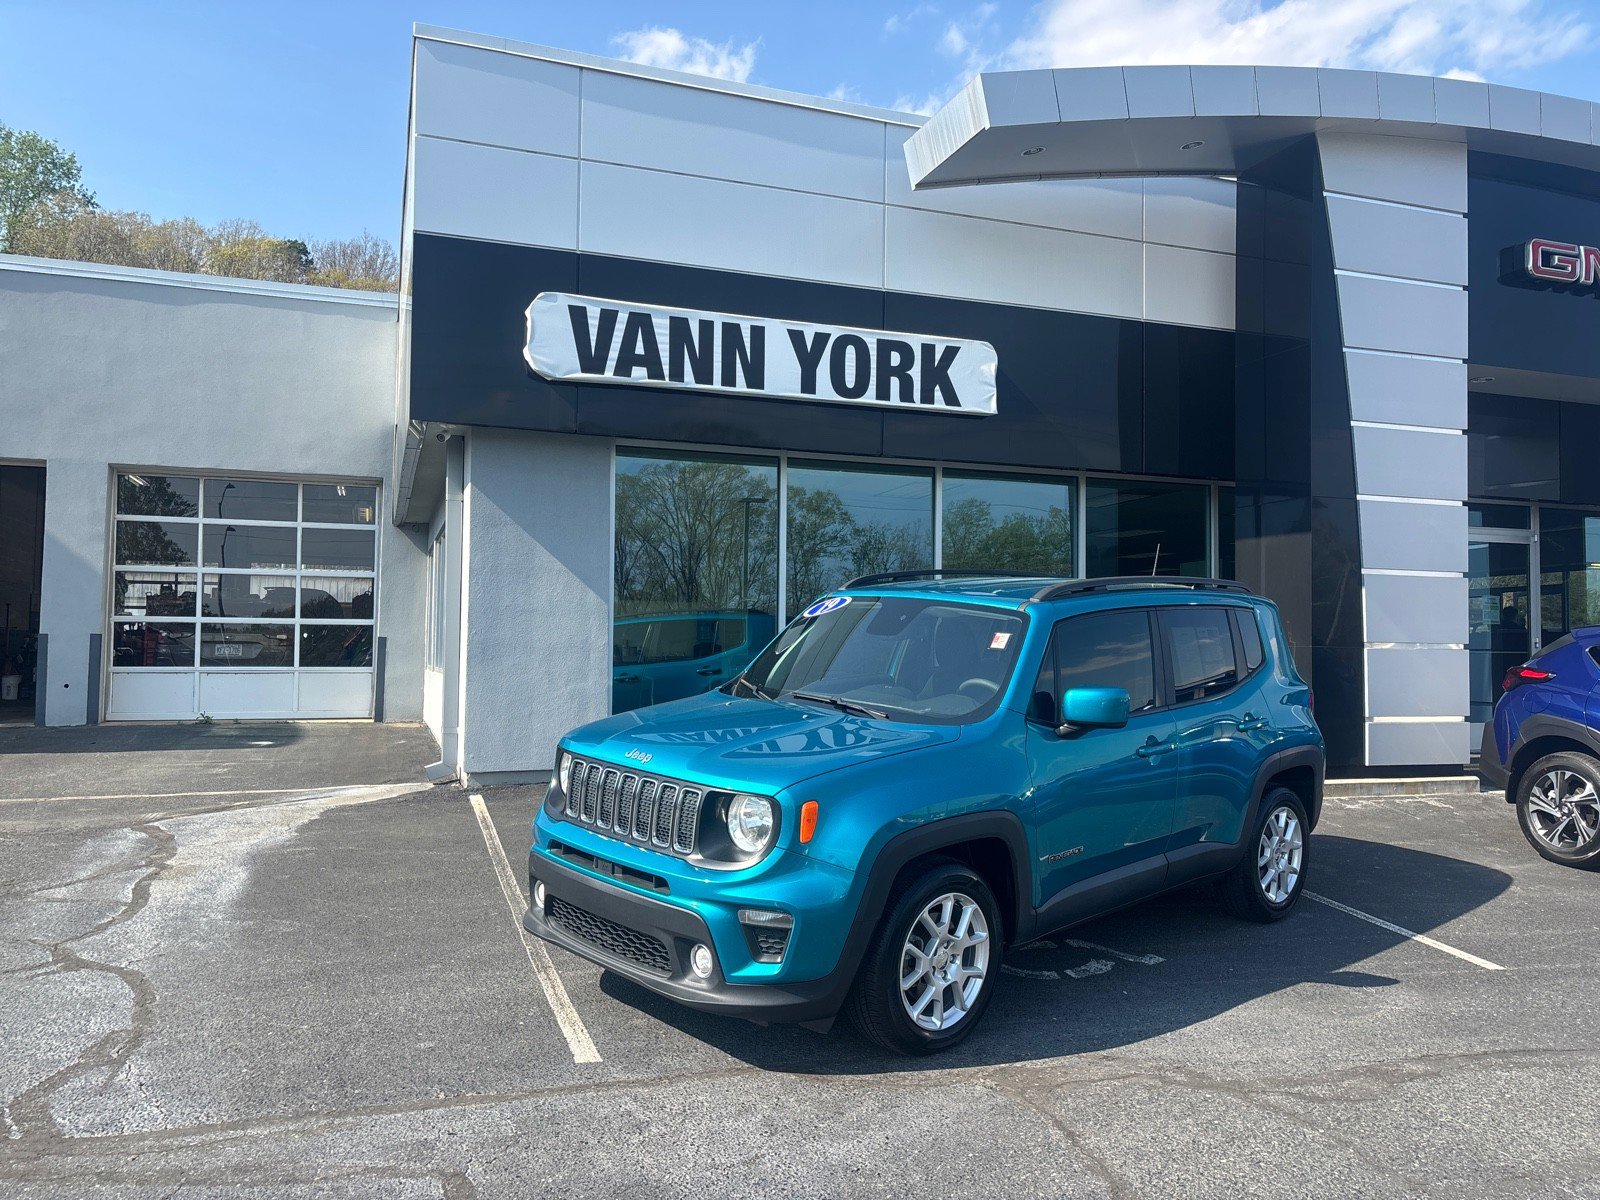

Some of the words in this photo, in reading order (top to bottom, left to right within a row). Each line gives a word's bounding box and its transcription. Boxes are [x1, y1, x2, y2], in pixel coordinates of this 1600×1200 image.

[568, 304, 766, 390] VANN
[786, 328, 962, 407] YORK
[625, 748, 653, 764] Jeep
